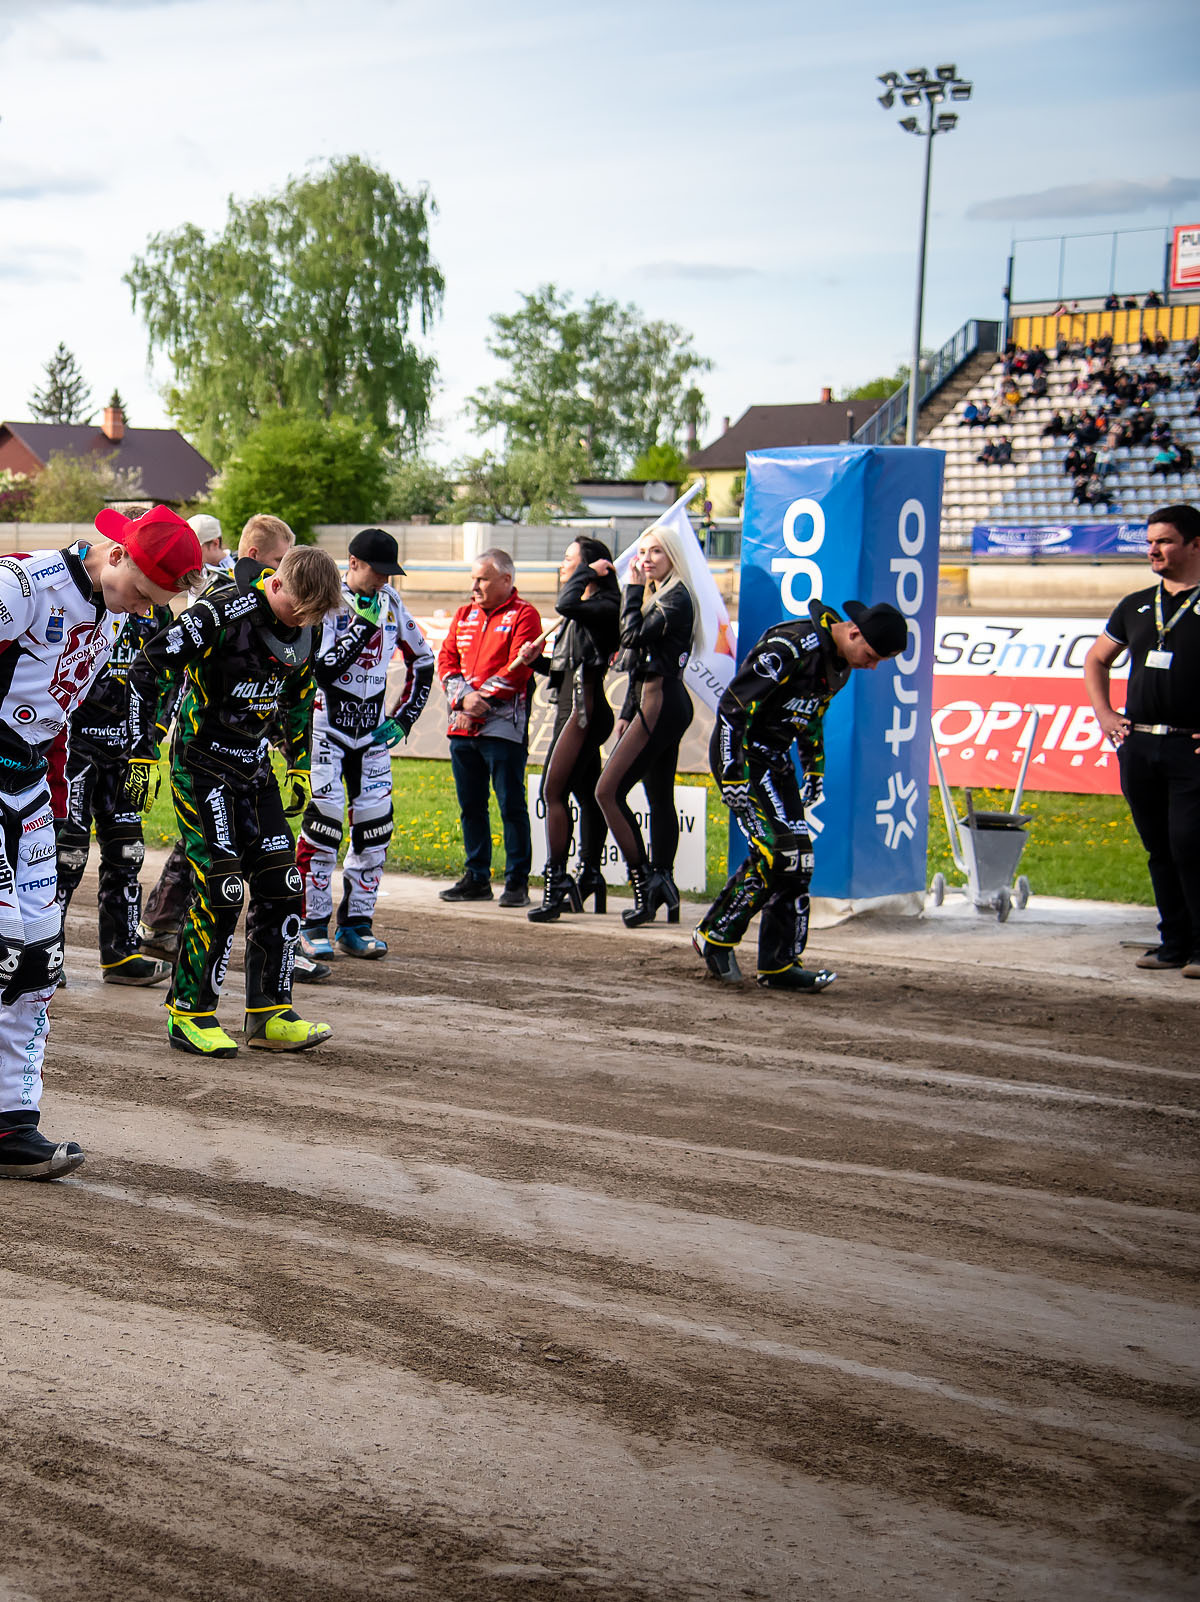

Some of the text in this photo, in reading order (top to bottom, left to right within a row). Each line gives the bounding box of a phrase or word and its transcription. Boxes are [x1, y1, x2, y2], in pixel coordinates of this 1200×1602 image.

[884, 498, 926, 757] trodo
[931, 700, 1118, 752] OPTIB
[205, 784, 238, 858] METALIKA
[18, 875, 58, 893] TROD
